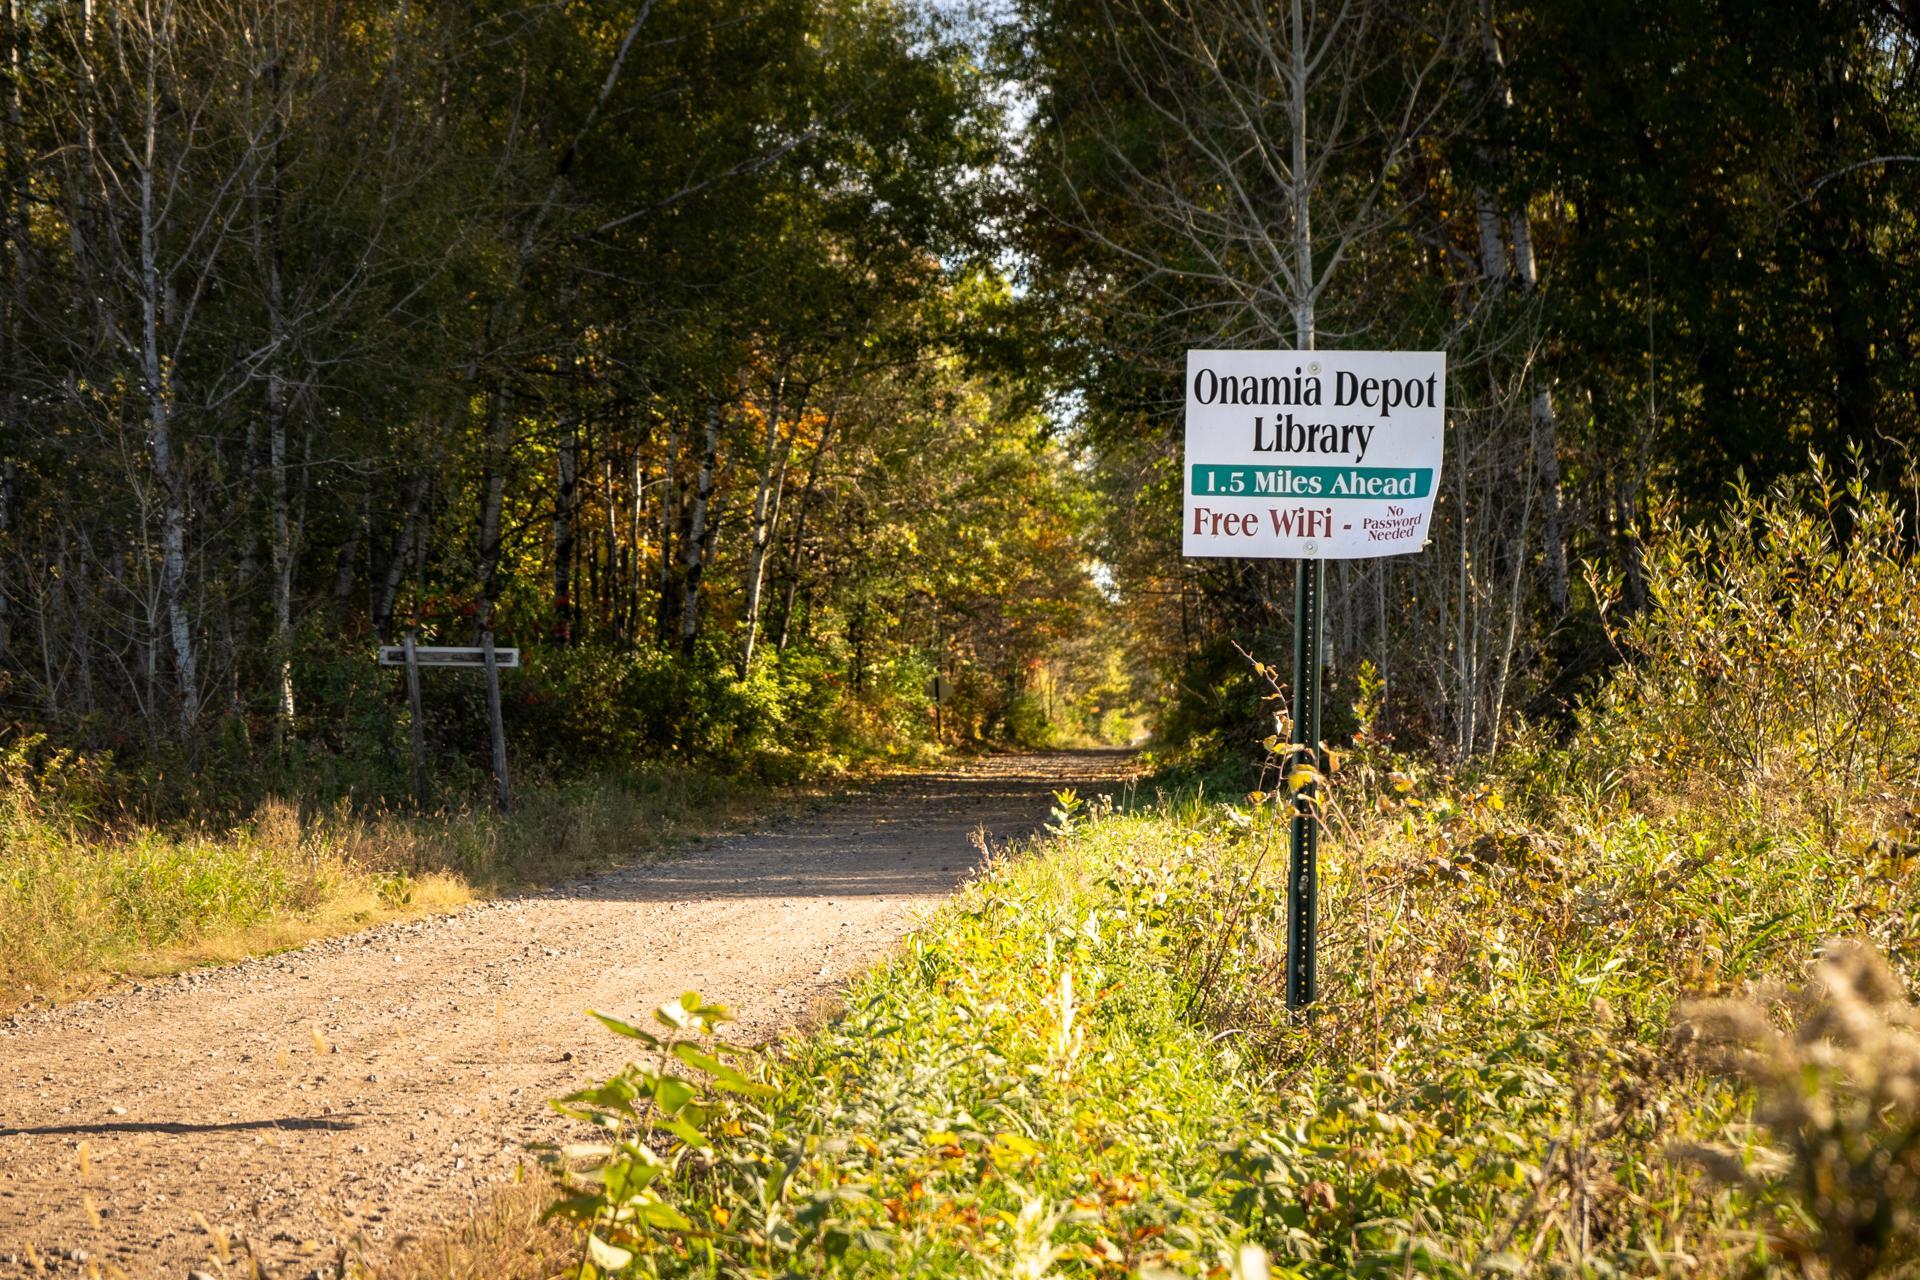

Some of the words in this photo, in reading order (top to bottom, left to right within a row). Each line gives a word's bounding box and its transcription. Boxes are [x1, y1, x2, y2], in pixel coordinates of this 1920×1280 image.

[1193, 366, 1322, 406] Onamia
[1333, 371, 1438, 417] Depot
[1252, 413, 1376, 464] Library
[1206, 471, 1245, 493] 1.5
[1253, 470, 1322, 494] Miles
[1330, 472, 1416, 496] Ahead
[1192, 507, 1259, 537] Free
[1268, 507, 1332, 538] WiFi
[1363, 513, 1422, 530] Password
[1386, 505, 1404, 517] No
[1368, 526, 1414, 541] Needed
